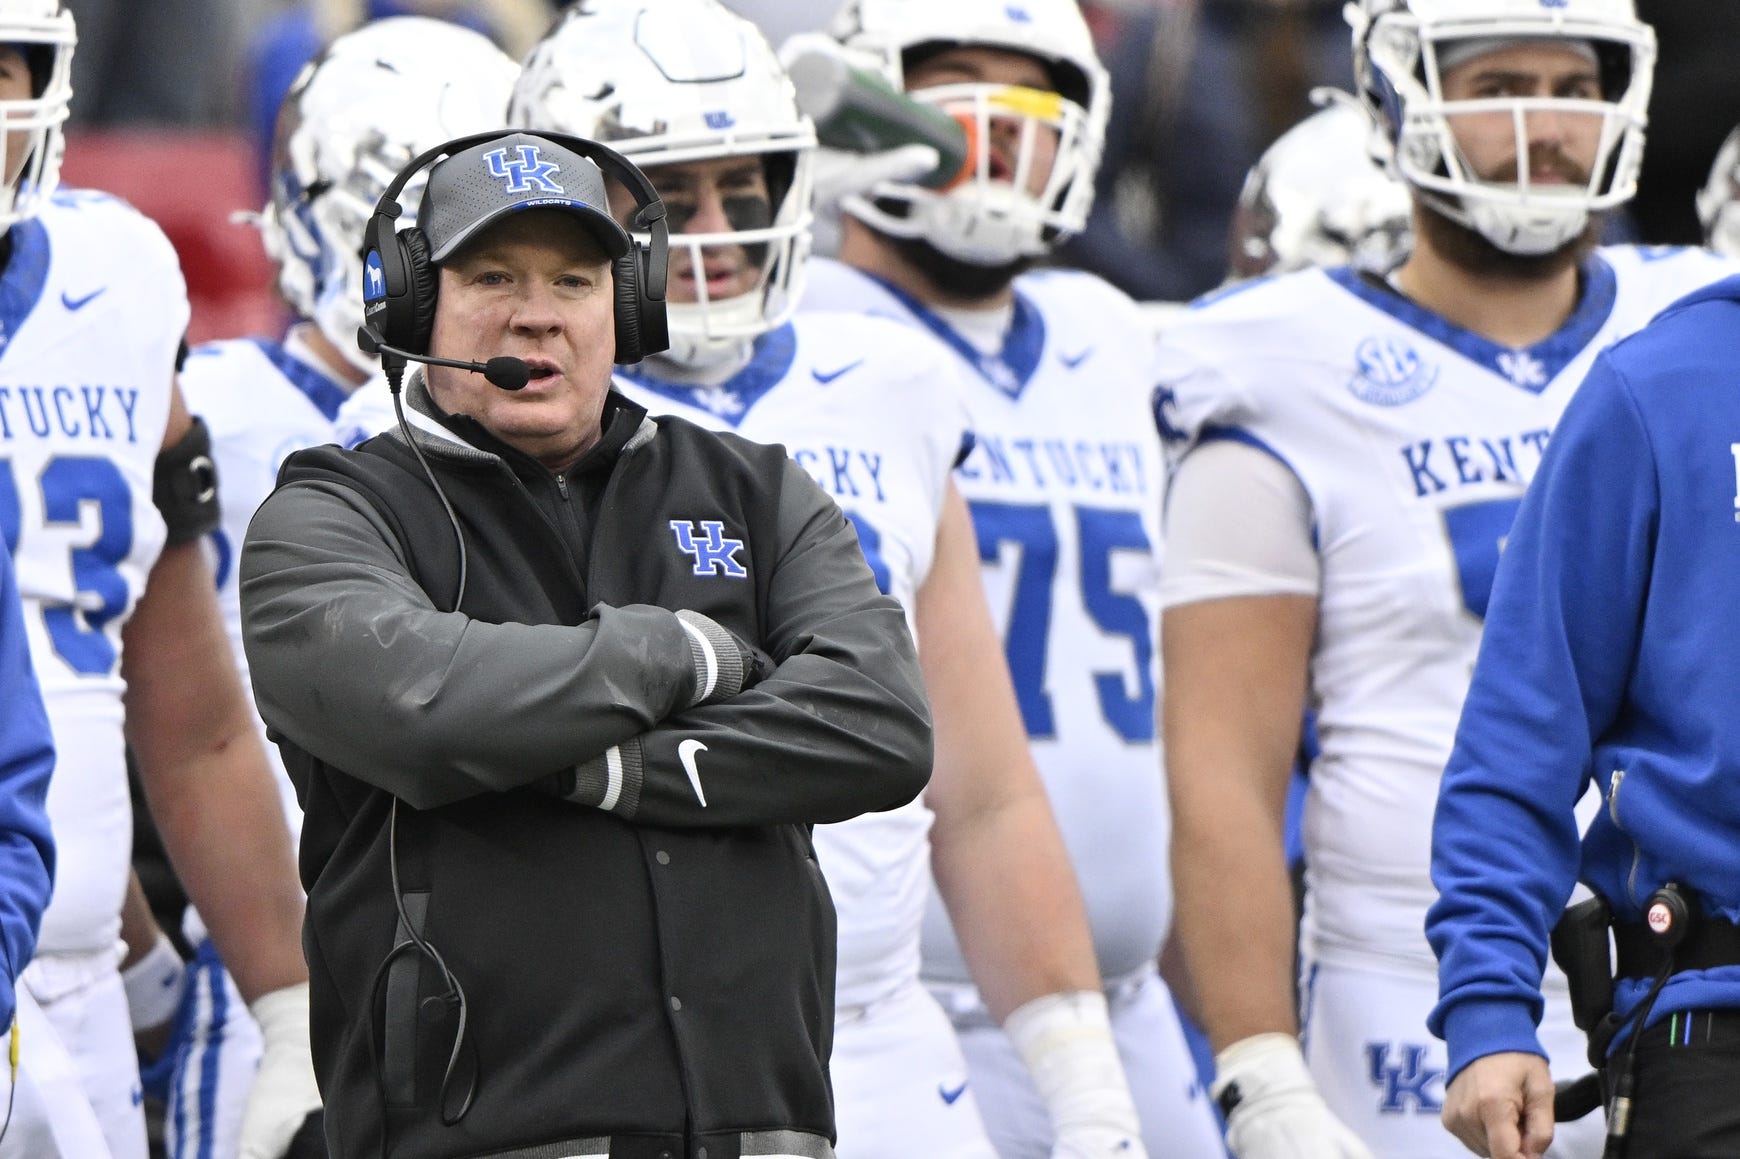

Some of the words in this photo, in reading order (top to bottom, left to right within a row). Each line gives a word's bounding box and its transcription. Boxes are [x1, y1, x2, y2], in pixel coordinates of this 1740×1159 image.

[482, 145, 565, 193] UK
[669, 520, 747, 578] UK
[965, 500, 1155, 745] 75
[1365, 1043, 1446, 1114] UK
